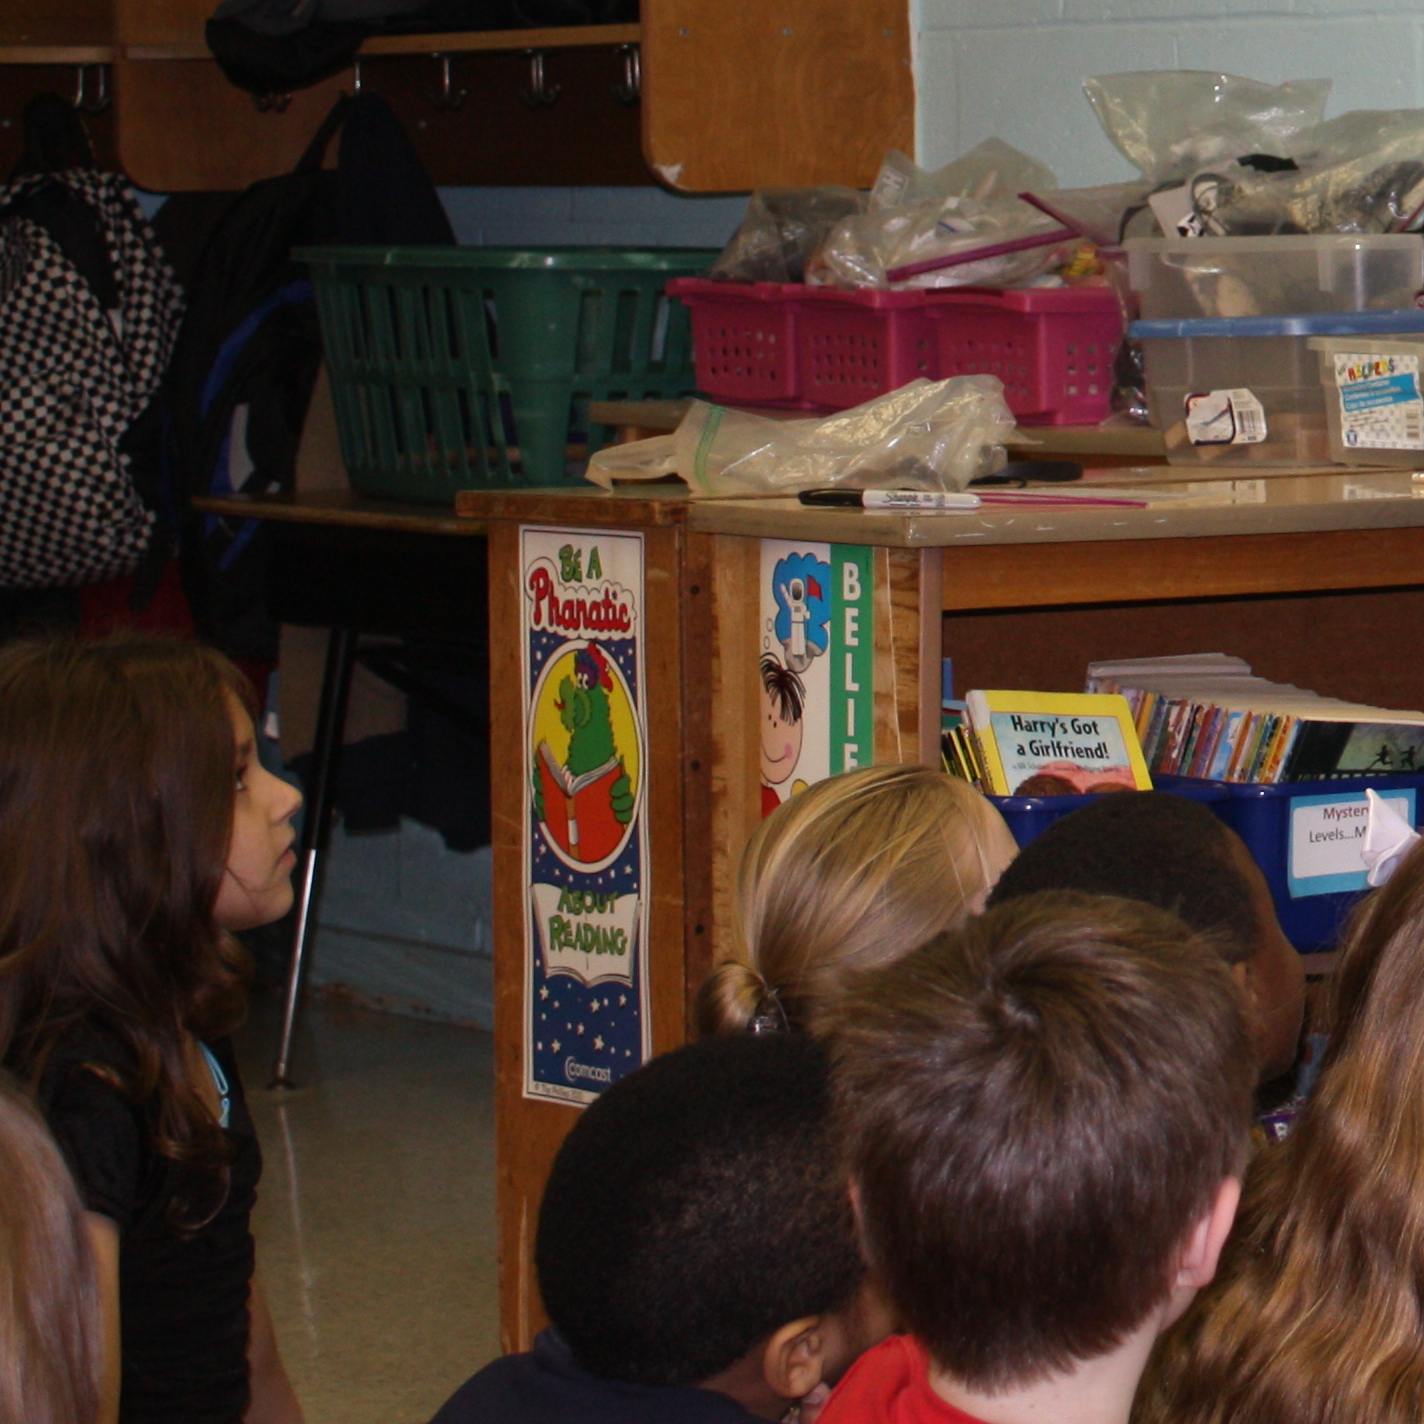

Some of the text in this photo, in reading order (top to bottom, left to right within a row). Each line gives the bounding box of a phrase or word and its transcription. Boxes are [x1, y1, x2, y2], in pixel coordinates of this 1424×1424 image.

[558, 544, 602, 583] BE A
[530, 567, 630, 633] Phanatic
[1011, 715, 1099, 738] Harry's Got
[1017, 740, 1109, 759] a Girlfriend!
[558, 885, 620, 915] ABOUT
[549, 915, 628, 956] READING
